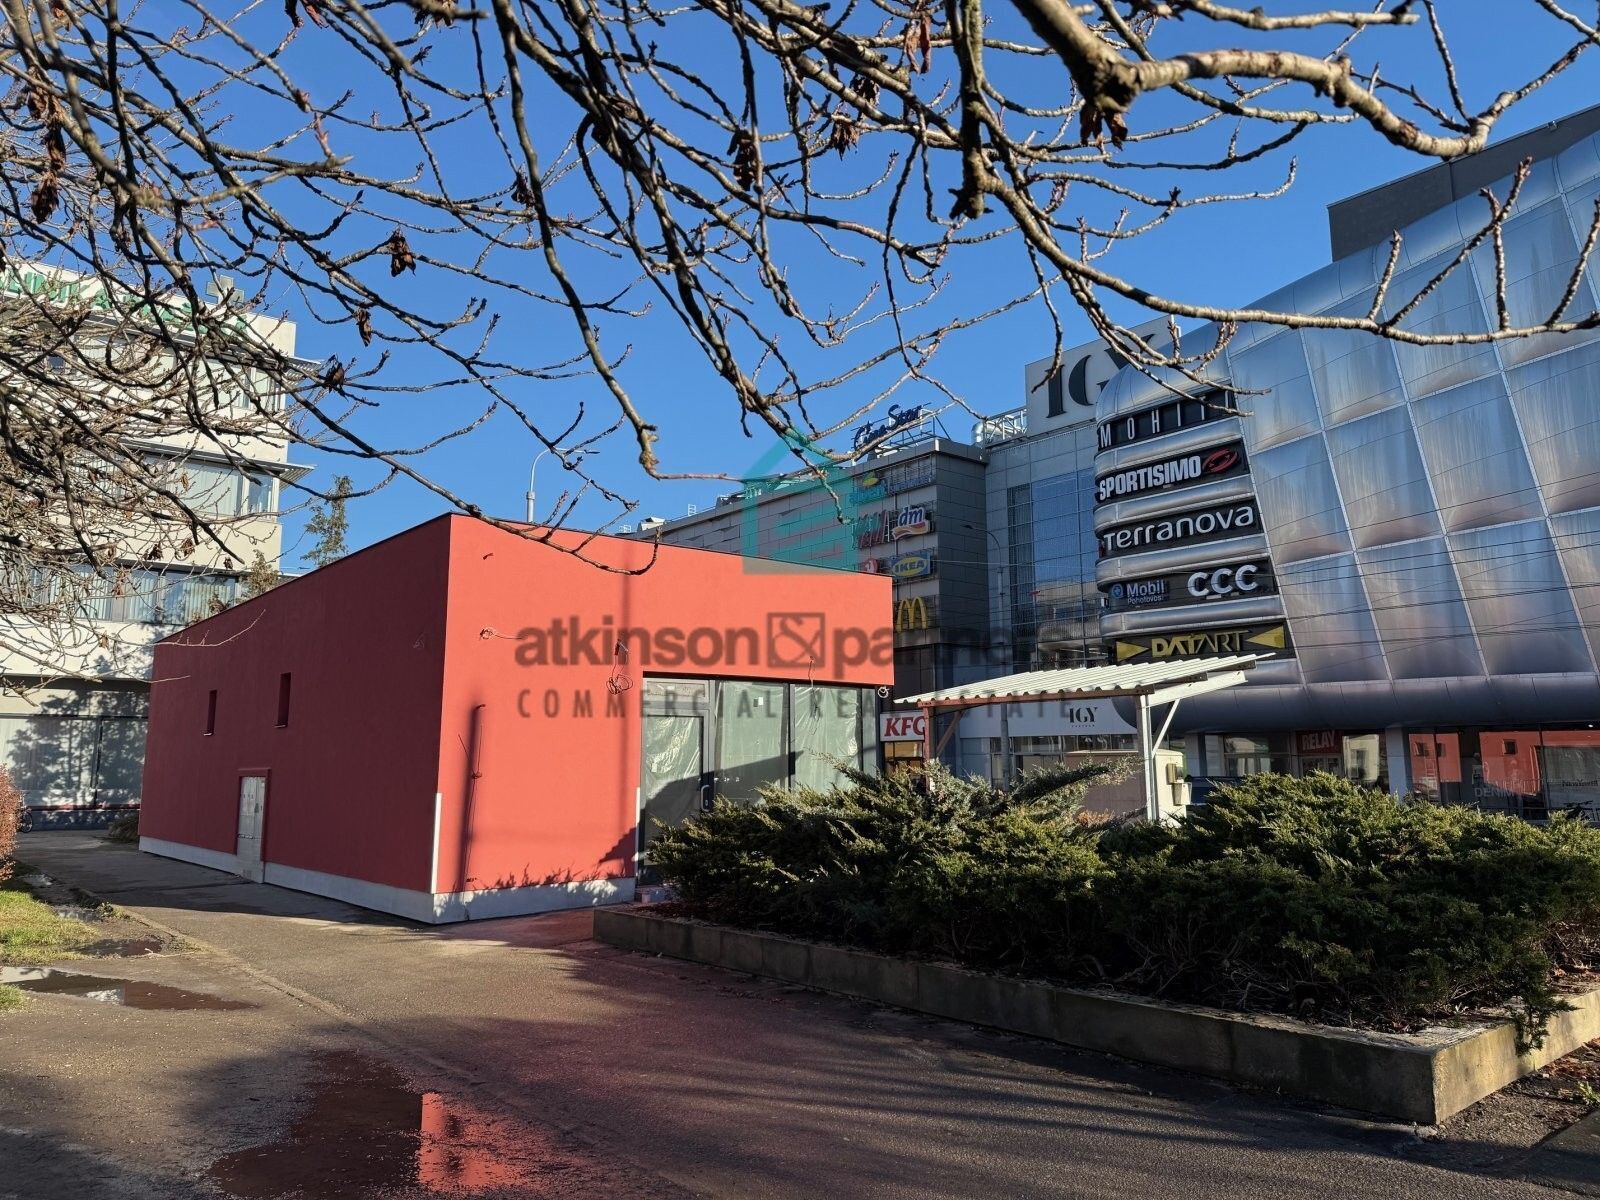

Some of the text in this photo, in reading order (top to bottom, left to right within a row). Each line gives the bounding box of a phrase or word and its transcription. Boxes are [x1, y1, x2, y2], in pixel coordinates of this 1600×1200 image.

[1099, 455, 1201, 501] SPORTISIMO
[900, 507, 923, 527] dm
[893, 557, 926, 574] IKEA
[1126, 579, 1165, 597] Mobil
[1187, 564, 1259, 597] CCC
[1151, 629, 1251, 659] DATART
[1069, 706, 1098, 723] IGY
[884, 715, 926, 737] KFC
[1302, 730, 1336, 751] RELAY
